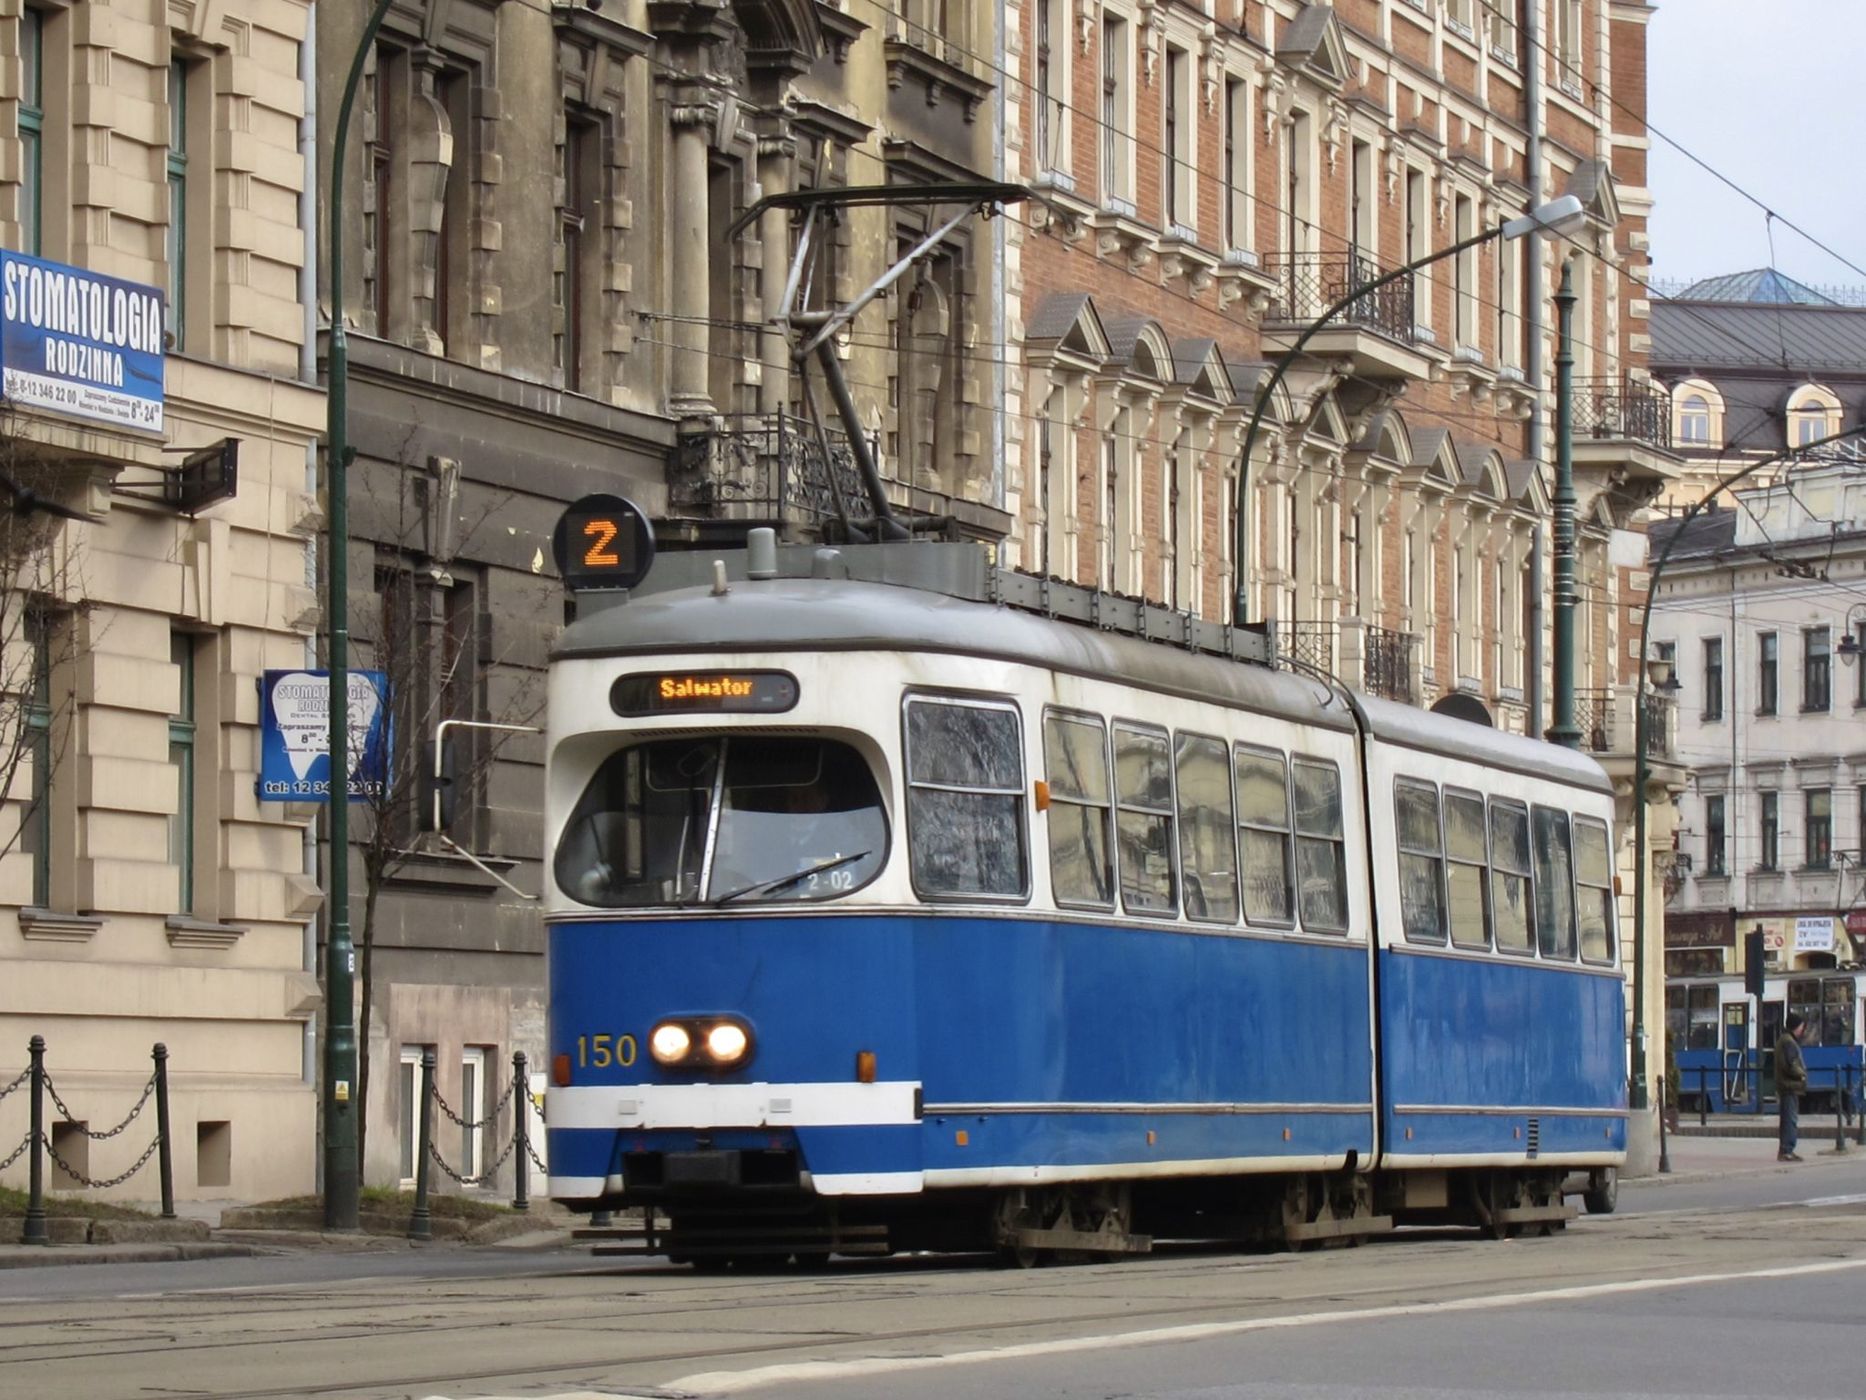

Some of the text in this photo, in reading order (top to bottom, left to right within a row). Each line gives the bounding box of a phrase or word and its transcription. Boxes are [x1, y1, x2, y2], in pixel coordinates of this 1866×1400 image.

[4, 260, 161, 355] STOMATOLOGIA
[45, 337, 124, 388] RODZINNA
[39, 383, 54, 400] 346
[55, 387, 65, 402] 22
[67, 389, 77, 405] 00
[583, 520, 619, 566] 2
[660, 678, 753, 698] Salwator
[264, 780, 290, 794] tel:
[293, 780, 312, 794] 12
[577, 1034, 637, 1068] 150
